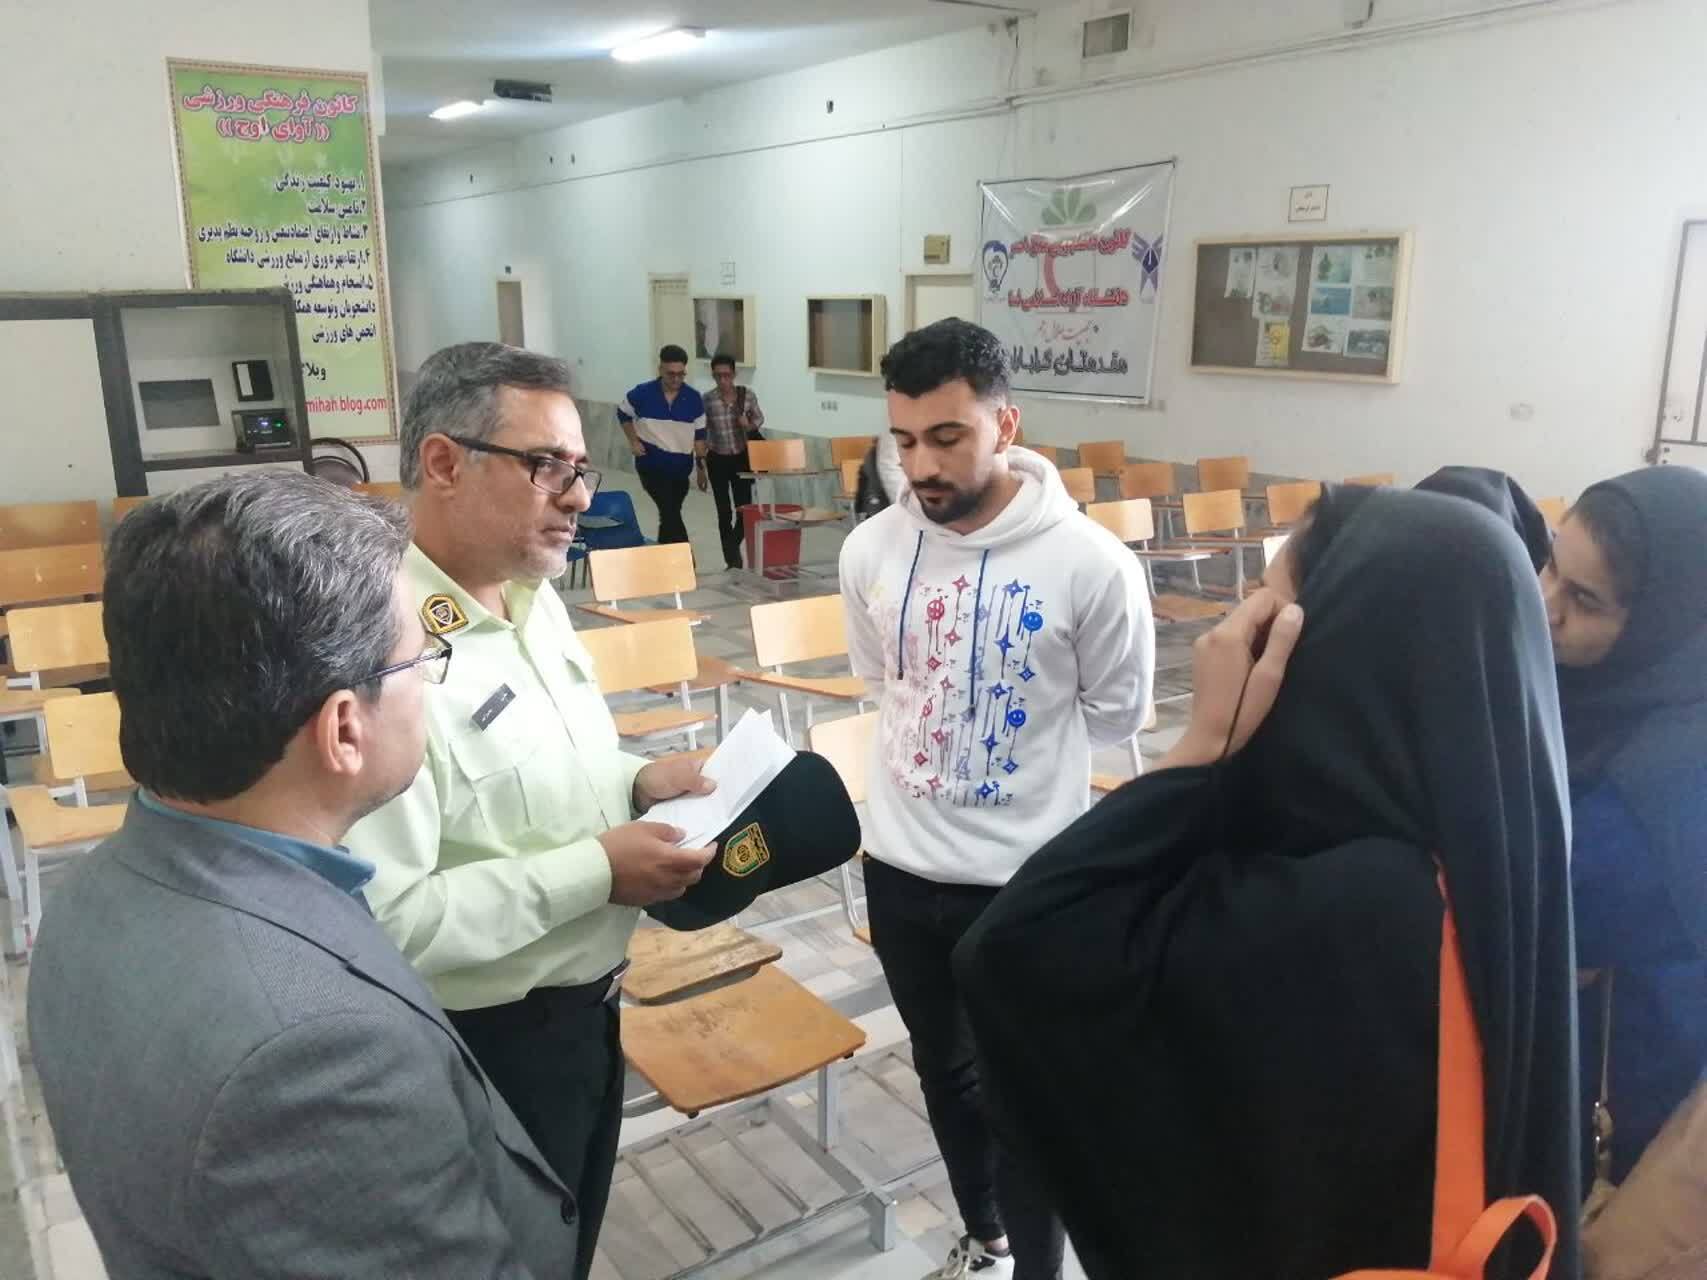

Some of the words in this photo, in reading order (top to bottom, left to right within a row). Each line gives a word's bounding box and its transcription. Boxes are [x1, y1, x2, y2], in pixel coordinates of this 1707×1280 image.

[183, 84, 246, 113] ورزشی
[247, 89, 312, 115] فرهنگی
[312, 93, 357, 117] کانون
[226, 248, 254, 264] دانشگاه
[301, 361, 327, 381] وبلا
